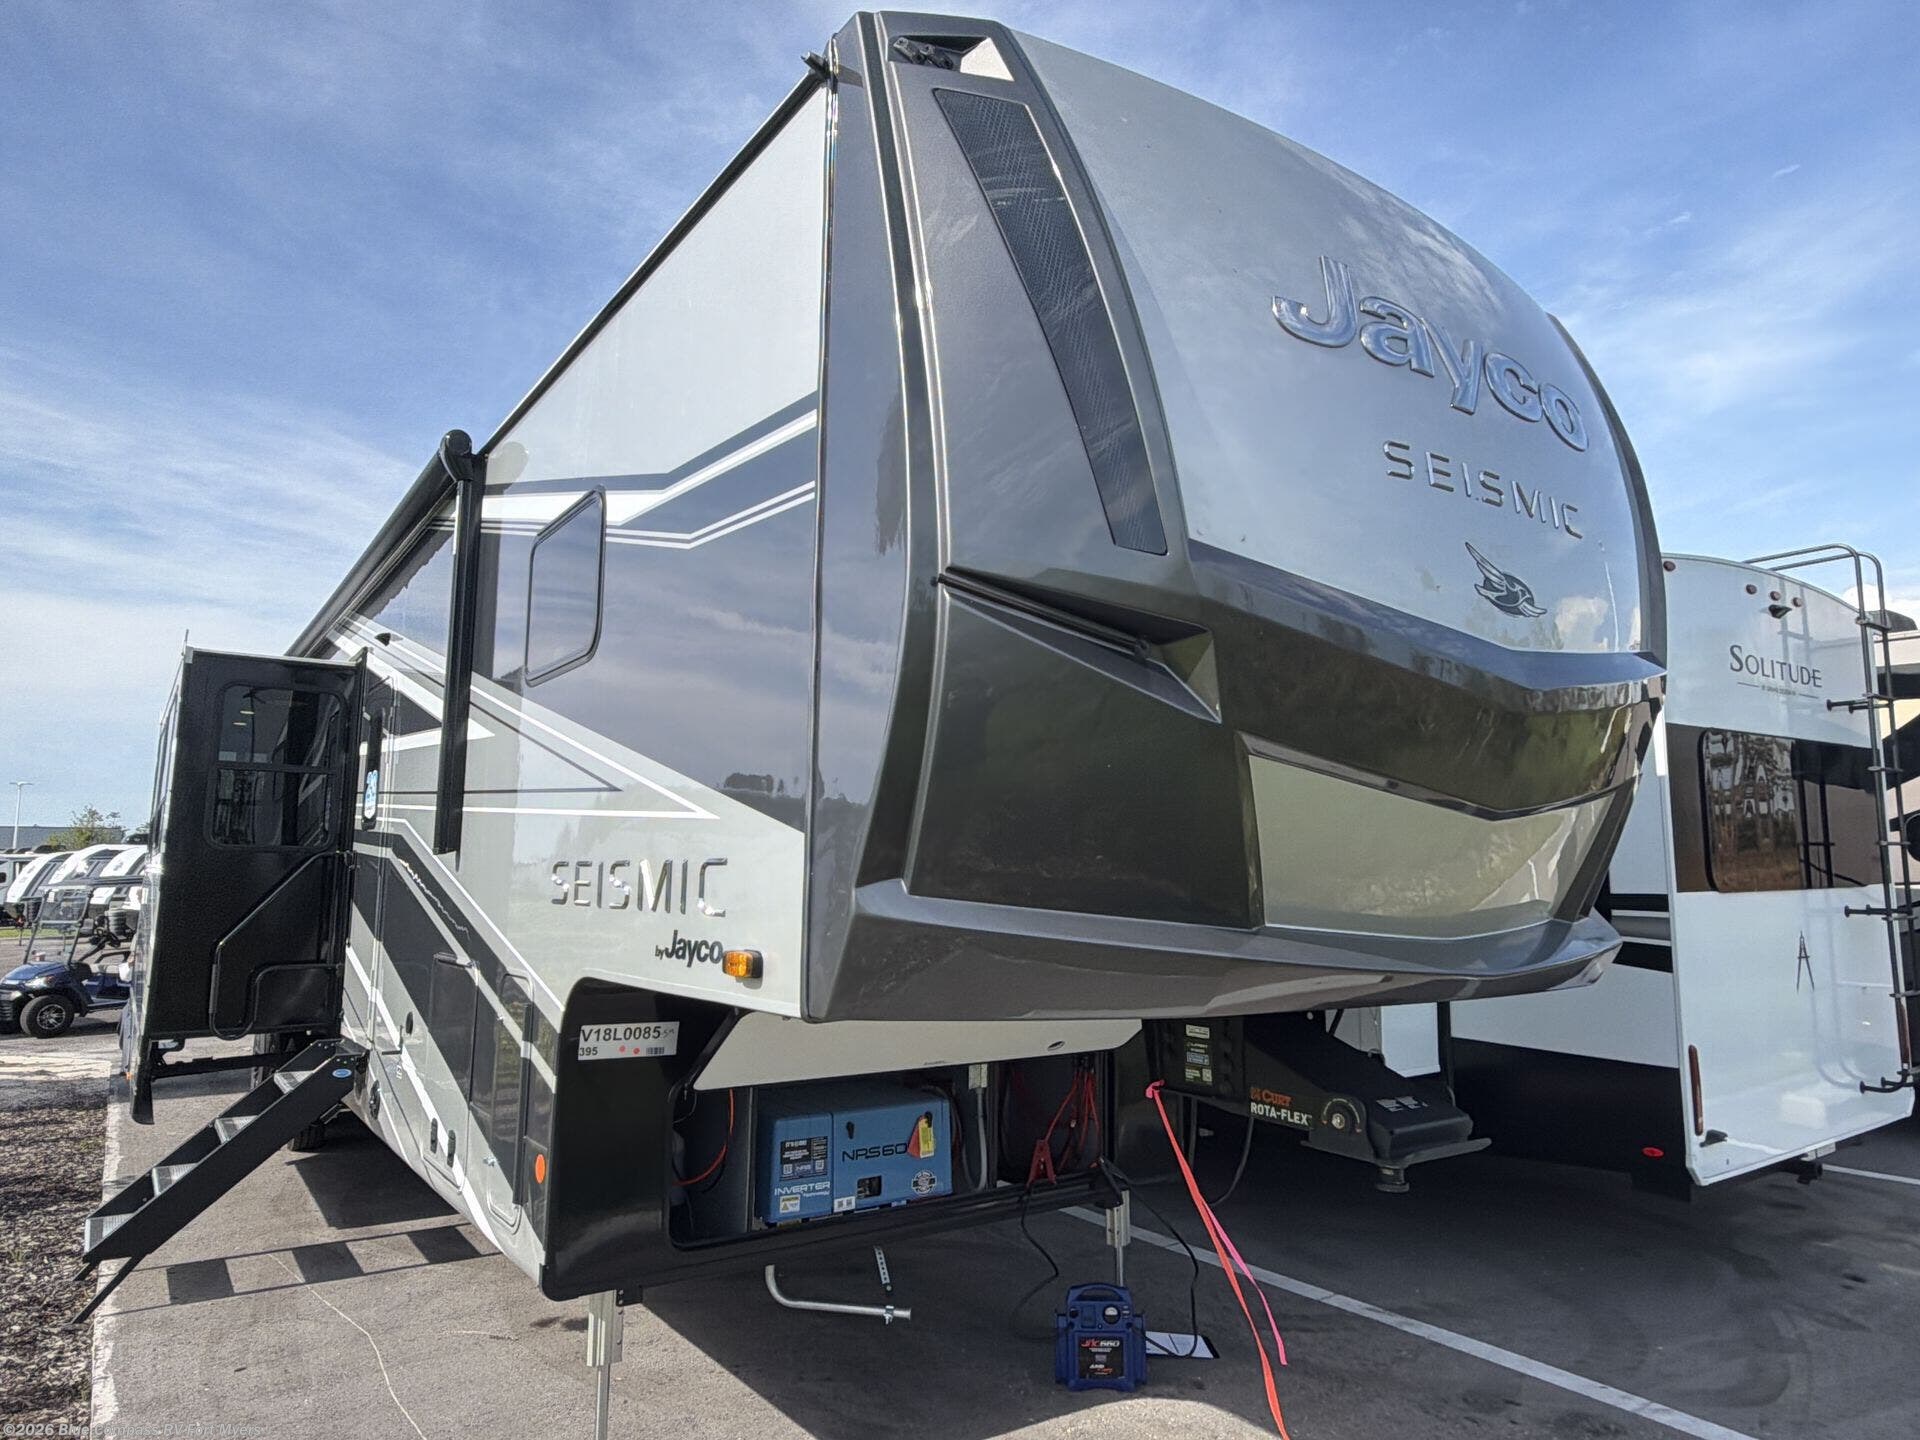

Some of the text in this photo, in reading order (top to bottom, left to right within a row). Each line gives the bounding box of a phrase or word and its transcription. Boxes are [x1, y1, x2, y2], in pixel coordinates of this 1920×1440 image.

[1272, 256, 1588, 452] Jayco
[1383, 440, 1582, 539] SEISMIC
[1730, 644, 1822, 688] SOLITUDE
[551, 858, 728, 917] SEISMIC
[665, 929, 723, 967] Jayco
[579, 1047, 598, 1056] 395
[580, 1025, 661, 1042] V18L0085
[1250, 1101, 1309, 1126] ROTA-FLEX
[774, 1181, 831, 1196] INVERTER
